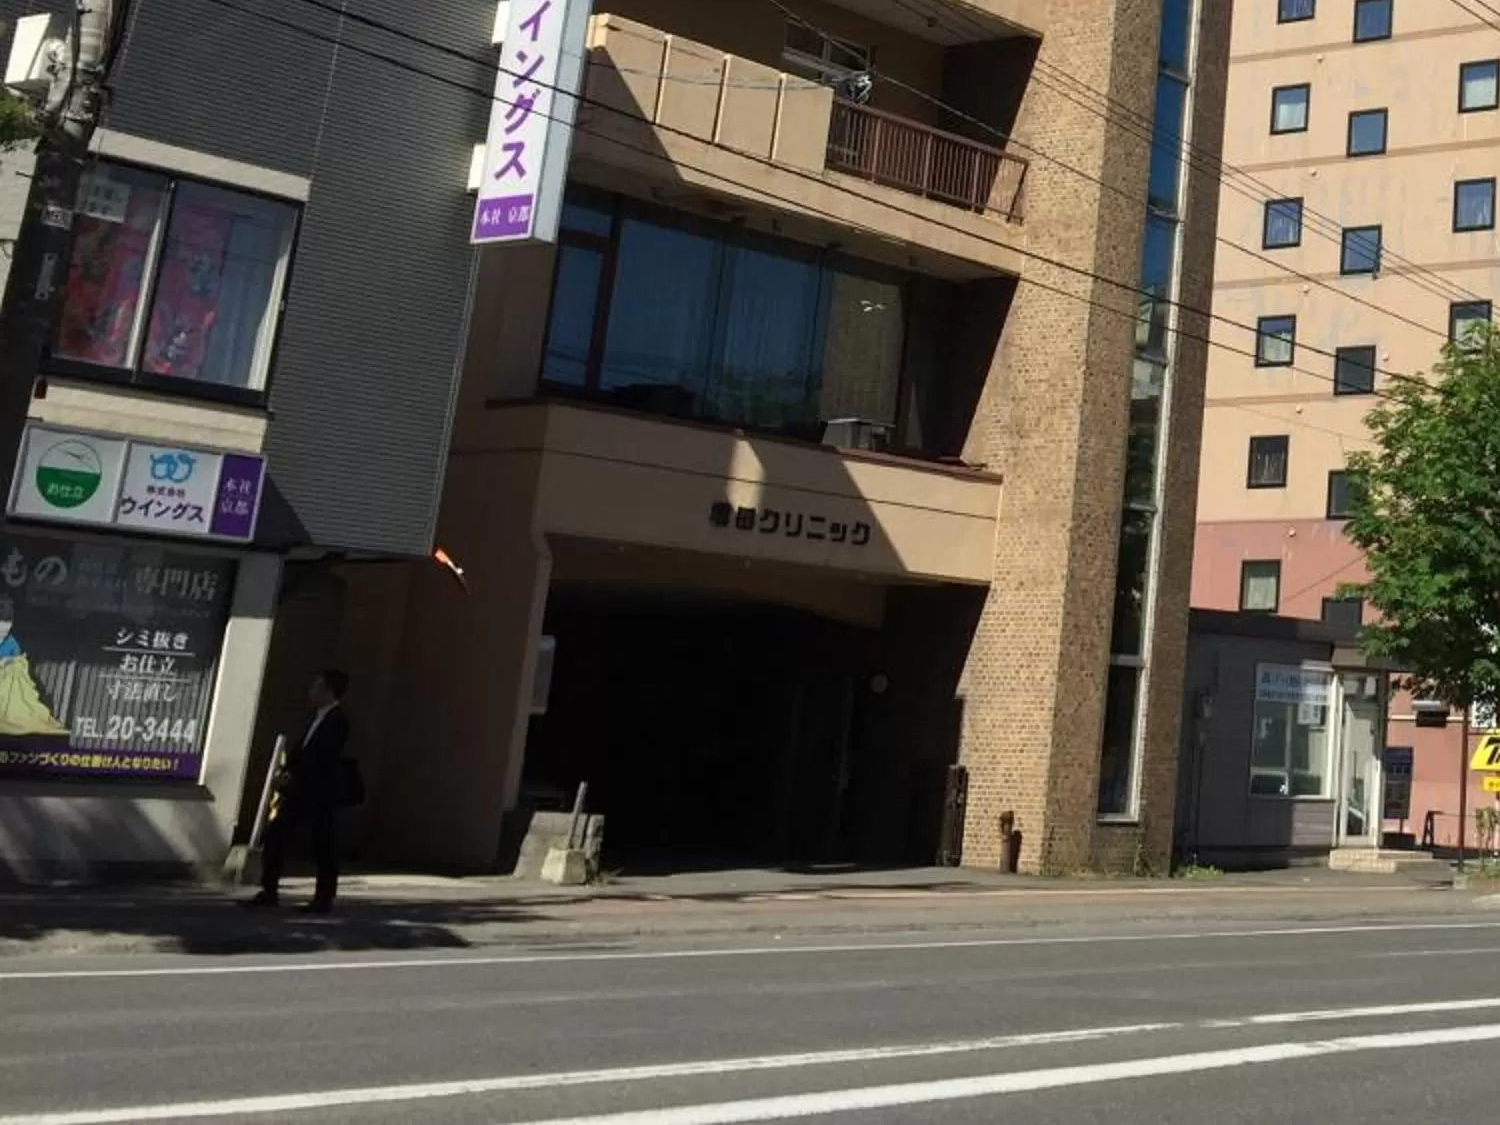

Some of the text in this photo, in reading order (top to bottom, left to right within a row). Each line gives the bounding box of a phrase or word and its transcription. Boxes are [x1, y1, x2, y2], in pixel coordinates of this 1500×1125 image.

[224, 477, 251, 495] 本社
[120, 495, 206, 524] ウイングス
[115, 628, 189, 651] シミ抜き
[119, 654, 177, 675] お仕立
[104, 715, 198, 744] 20-3444
